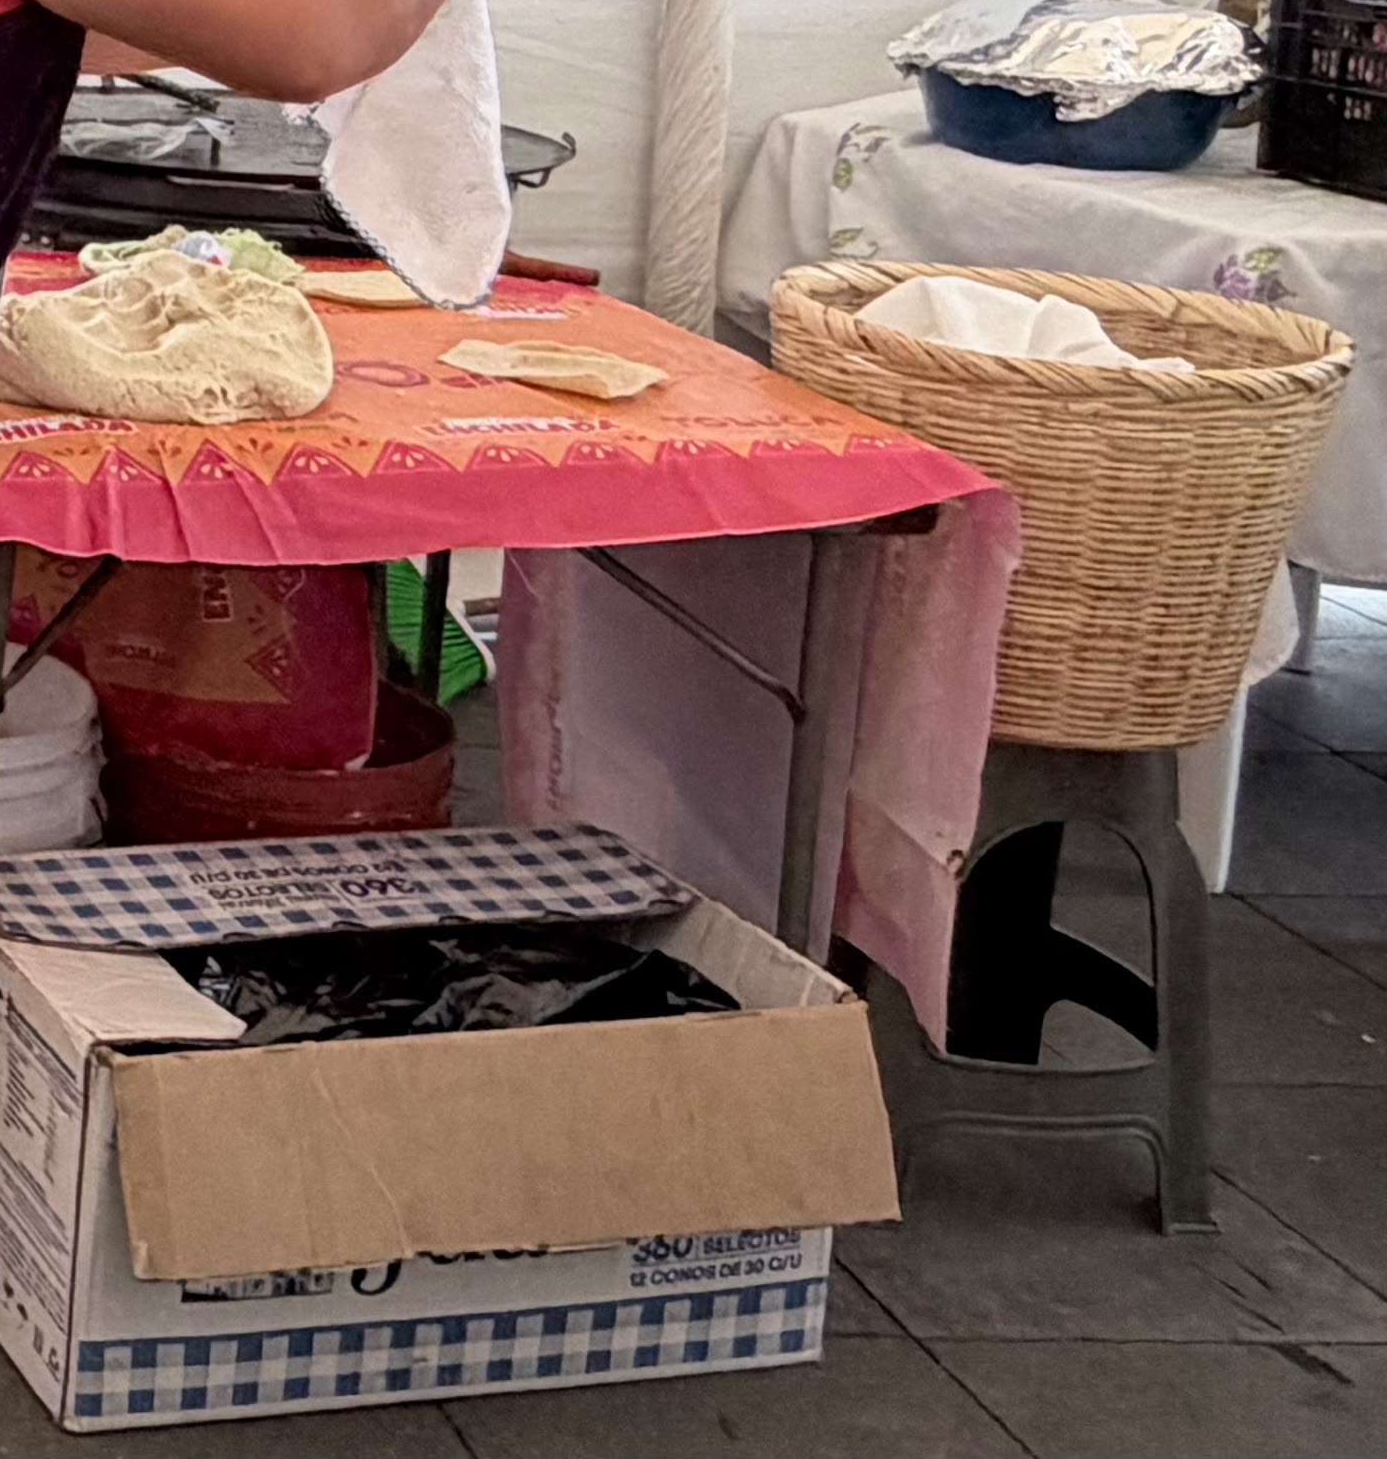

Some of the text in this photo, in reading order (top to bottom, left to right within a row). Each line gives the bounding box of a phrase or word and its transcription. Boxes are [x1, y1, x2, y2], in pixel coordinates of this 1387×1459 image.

[208, 877, 416, 900] 360 SELECTOS
[629, 1253, 803, 1288] 12 CONOS DE 30 C/U
